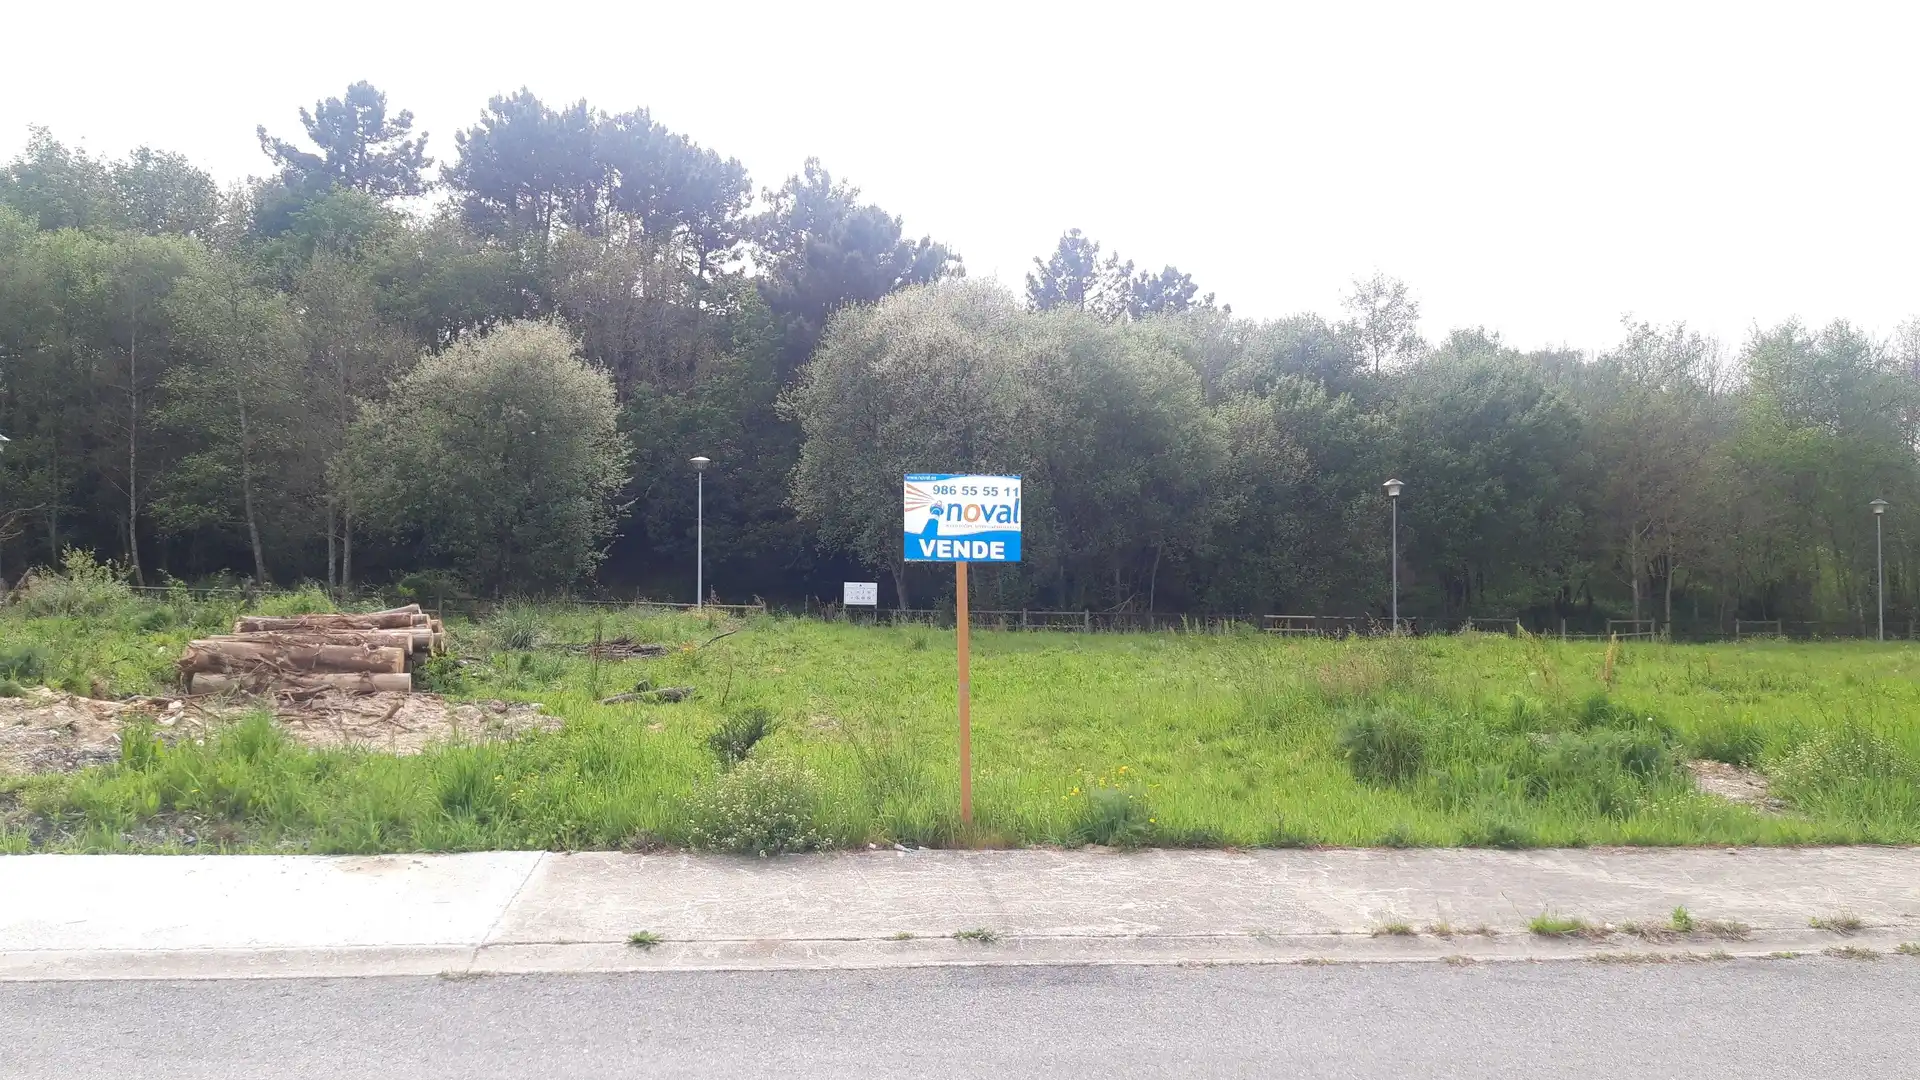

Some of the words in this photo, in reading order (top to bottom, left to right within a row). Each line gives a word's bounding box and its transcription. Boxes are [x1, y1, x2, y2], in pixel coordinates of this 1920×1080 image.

[932, 485, 957, 495] 986
[961, 486, 978, 496] 55
[982, 486, 999, 497] 55
[1004, 487, 1019, 497] 11
[946, 498, 1020, 524] noval
[918, 538, 1005, 560] VENDE
